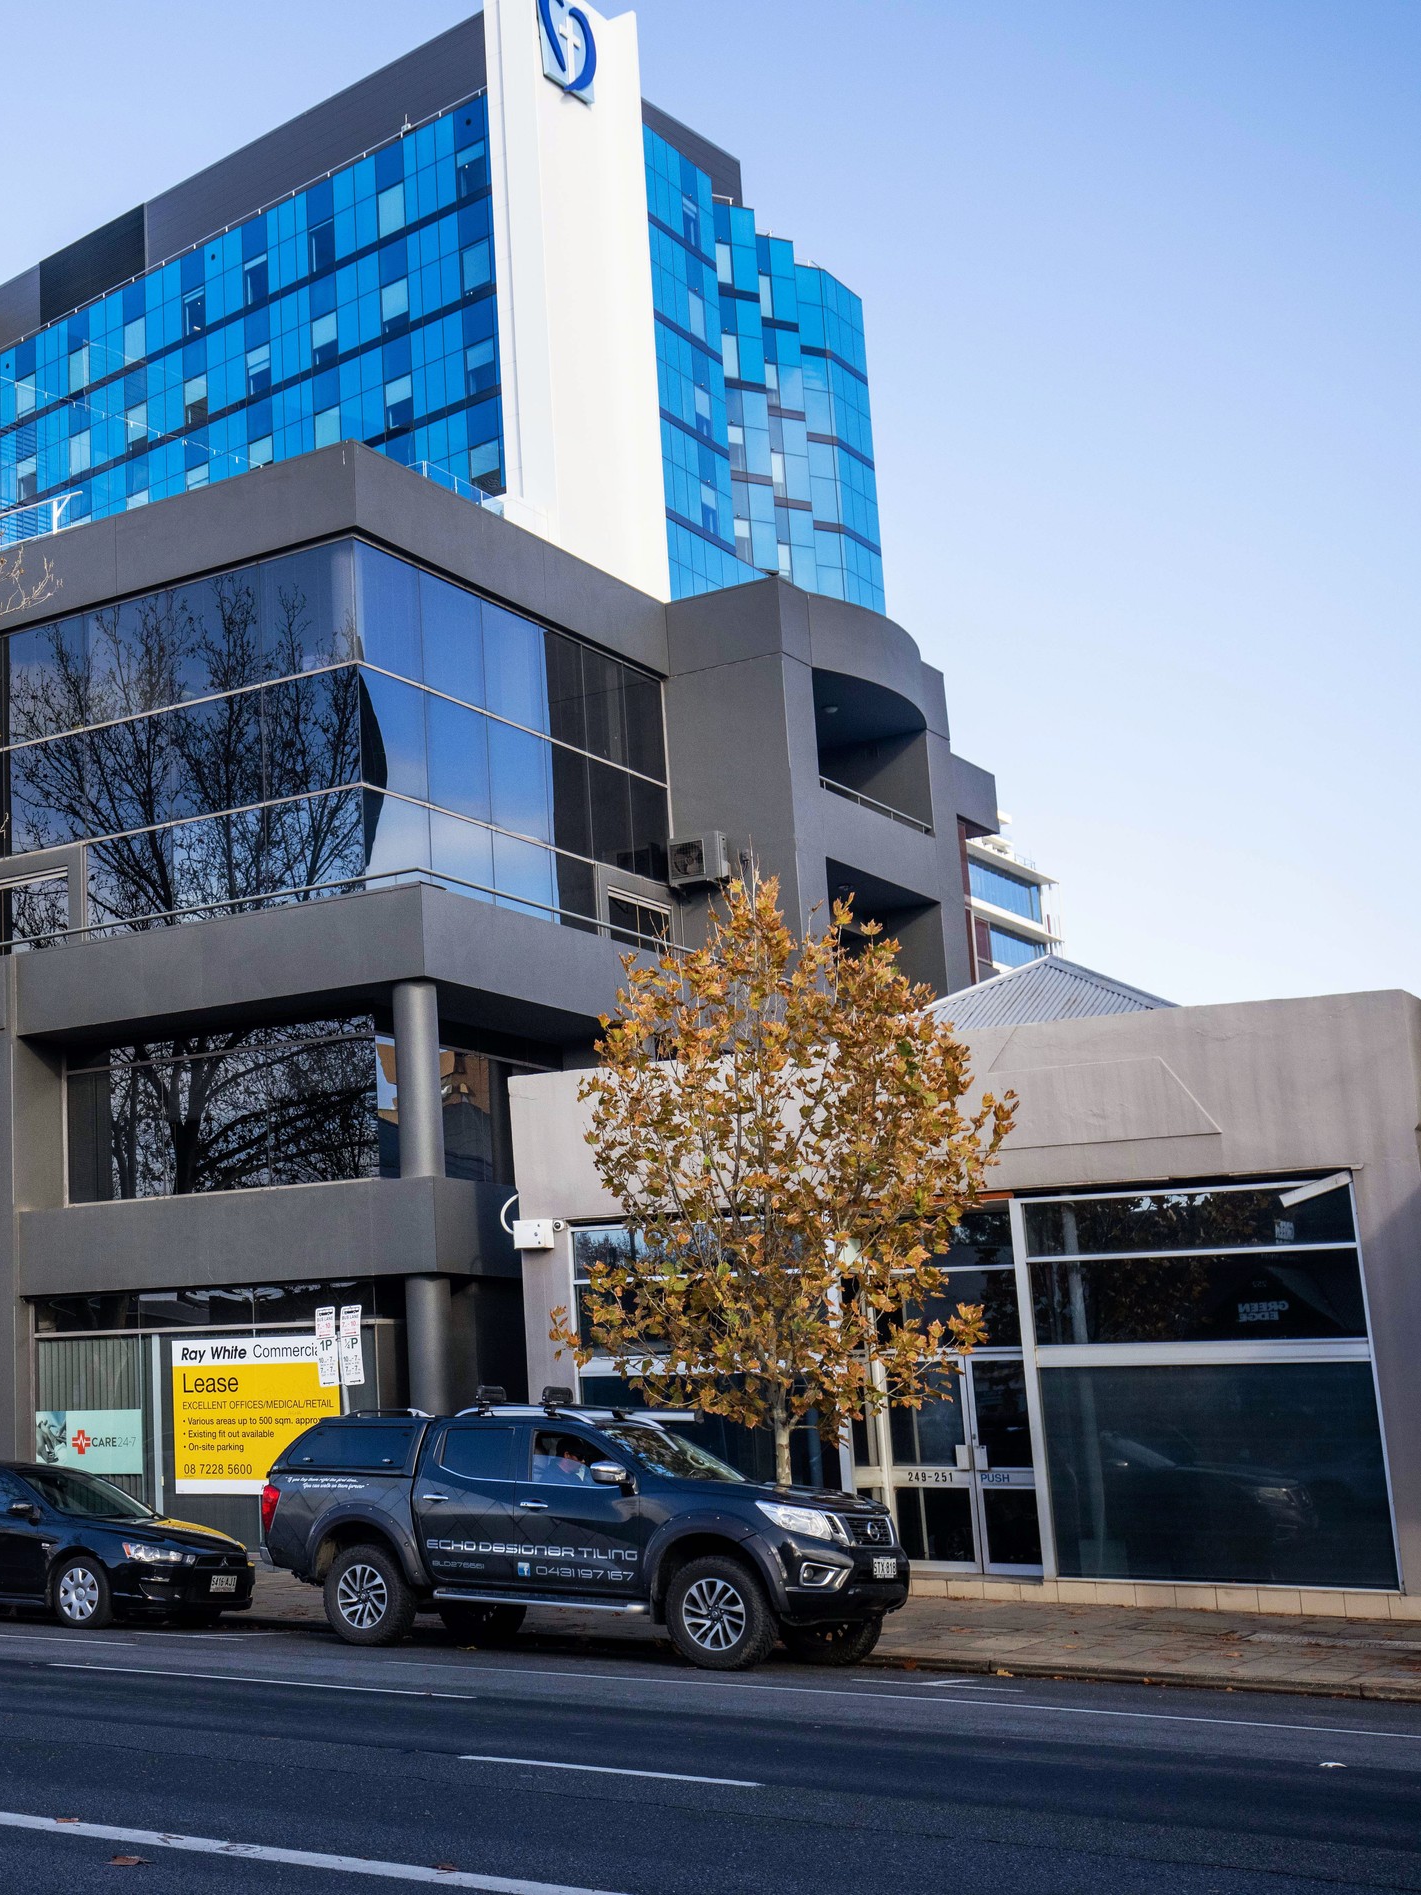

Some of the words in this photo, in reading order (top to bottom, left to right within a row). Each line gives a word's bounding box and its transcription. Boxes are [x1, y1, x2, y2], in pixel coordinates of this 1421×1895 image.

[320, 1340, 332, 1351] 1P
[181, 1347, 206, 1363] Ray
[211, 1346, 247, 1359] White
[253, 1342, 318, 1358] Commerci
[183, 1373, 238, 1393] Lease
[182, 1401, 227, 1410] EXCELLENT
[229, 1399, 334, 1409] OFFICES/MEDICAL/RETAIL
[188, 1417, 214, 1425] Various
[275, 1418, 293, 1426] sqm.
[188, 1430, 216, 1440] Existing
[217, 1443, 244, 1452] parking
[184, 1464, 196, 1475] 08
[200, 1464, 224, 1475] 7228
[228, 1464, 252, 1475] 5600
[908, 1472, 953, 1482] 249-251
[981, 1474, 1010, 1482] PUSH
[427, 1539, 476, 1550] ECHO
[578, 1548, 638, 1560] TILING
